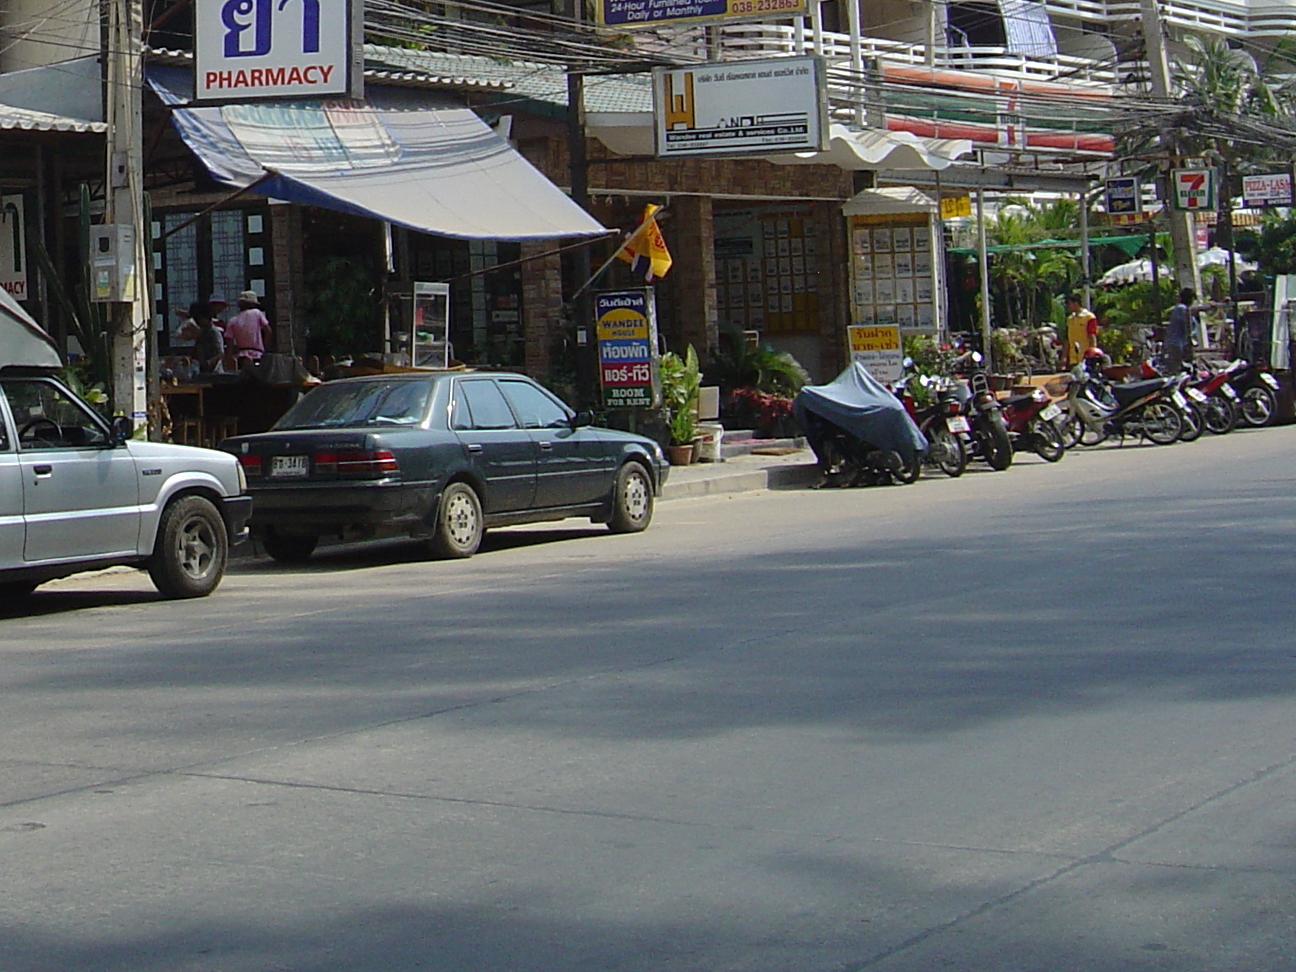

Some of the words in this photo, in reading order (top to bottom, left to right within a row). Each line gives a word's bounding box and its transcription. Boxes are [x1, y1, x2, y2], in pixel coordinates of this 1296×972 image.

[610, 0, 645, 13] 24-Hour
[627, 9, 649, 21] Daily
[653, 10, 663, 18] or
[666, 6, 704, 17] Monthly
[205, 65, 334, 90] PHARMACY
[602, 319, 644, 328] WANDEE
[602, 342, 648, 359] ห้องพัก
[605, 364, 649, 382] แอร์-ทีวี
[612, 388, 645, 398] ROOM
[607, 398, 624, 406] FOR
[626, 397, 651, 406] RENT
